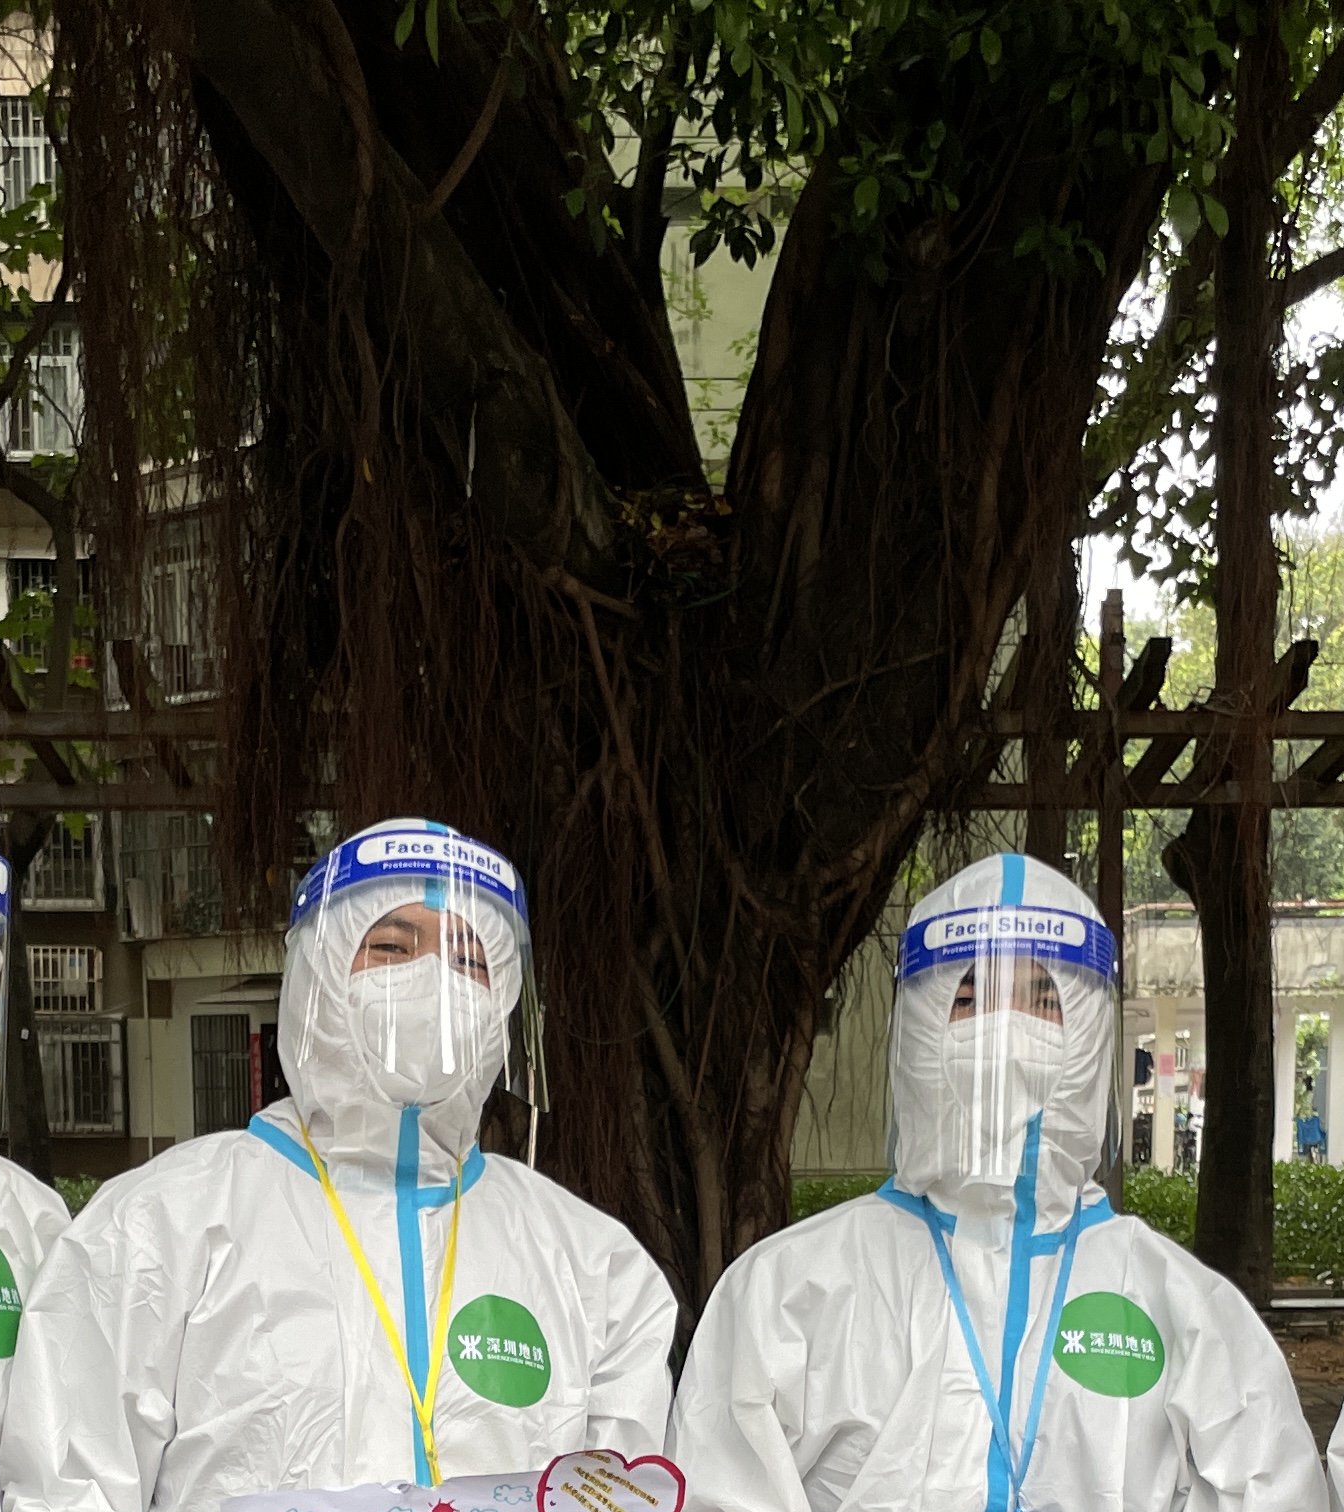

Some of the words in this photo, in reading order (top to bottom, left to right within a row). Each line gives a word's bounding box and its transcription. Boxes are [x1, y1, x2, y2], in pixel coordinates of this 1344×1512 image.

[382, 861, 431, 871] Protective
[384, 841, 434, 855] Face
[443, 842, 501, 875] Shield
[945, 921, 989, 939] Face
[998, 917, 1065, 936] Shield
[942, 942, 985, 956] Protective
[486, 1337, 545, 1364] 深圳地铁
[1090, 1332, 1155, 1354] 深圳地铁
